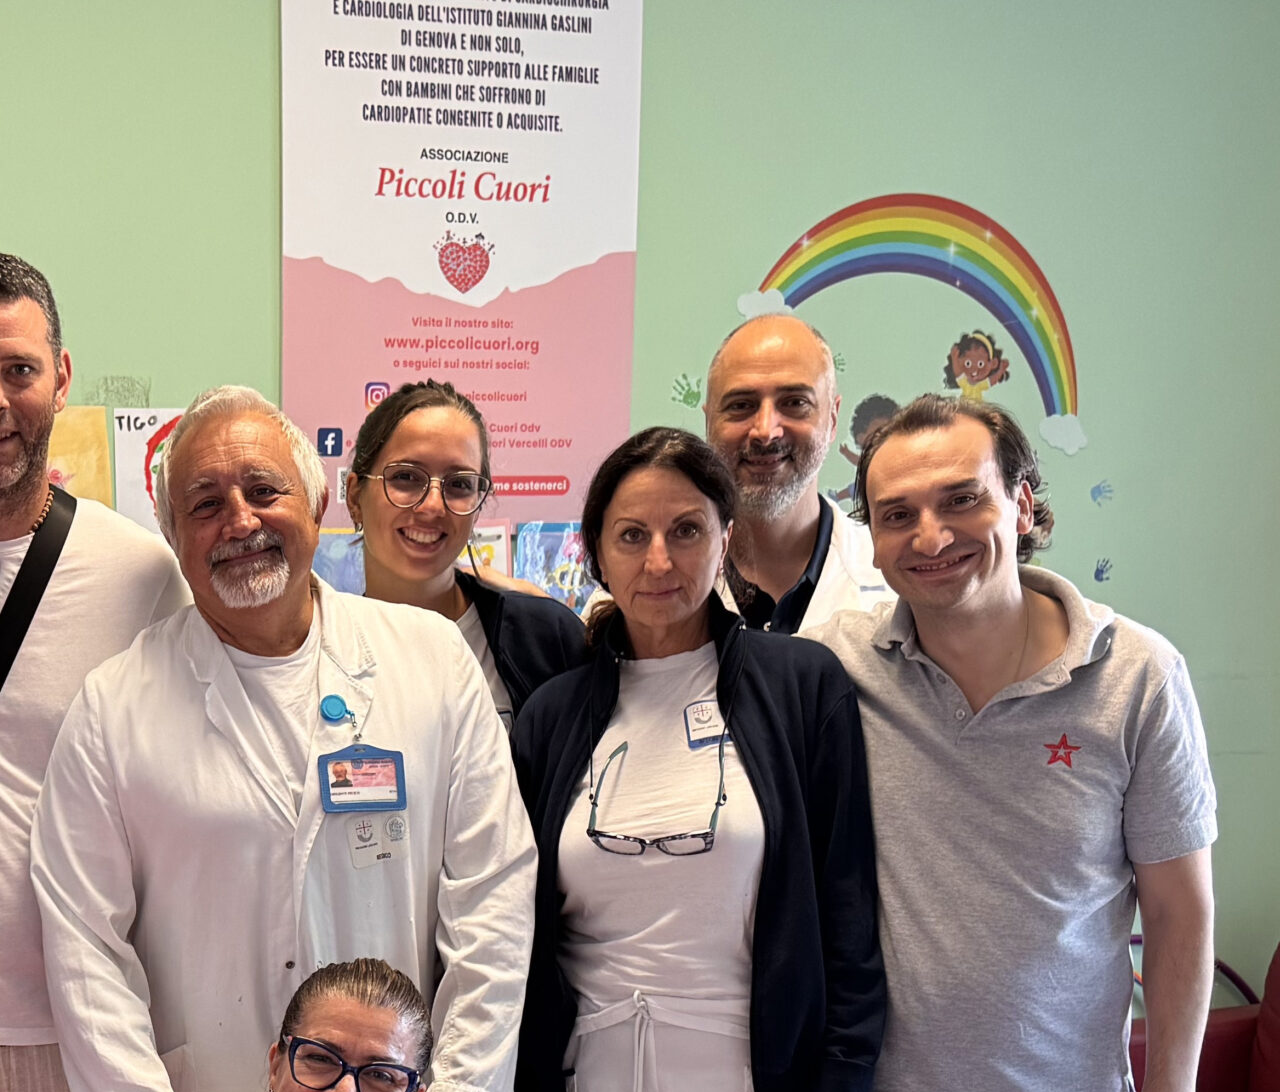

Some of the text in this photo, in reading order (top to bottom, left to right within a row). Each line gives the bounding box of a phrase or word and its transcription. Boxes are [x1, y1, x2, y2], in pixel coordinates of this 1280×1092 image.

[333, 0, 340, 15] E
[343, 0, 414, 20] CARDIOLOGIA
[418, 5, 492, 26] DELL'ISTITUTO
[497, 12, 547, 30] GIANNINA
[551, 15, 591, 33] GASLINI
[401, 29, 524, 56] DI GENOVA E NON SOLO,
[325, 49, 599, 84] PER ESSERE UN CONCRETO SUPPORTO ALLE FAMIGLIE
[381, 79, 545, 106] CON BAMBINI CHE SOFFRONO DI
[363, 104, 562, 132] CARDIOPATIE CONGENITE O ACQUISITE.
[420, 148, 508, 163] ASSOCIAZIONE
[375, 168, 551, 203] Piccoli Cuori
[446, 212, 479, 224] O.D.V.
[411, 317, 513, 329] Visita il nostro sito:
[384, 336, 540, 355] www.piccolicuori.org
[393, 359, 530, 371] o seguici sui nostri social:
[489, 423, 541, 433] Cuori Odv
[509, 439, 548, 448] Vercelli
[550, 438, 572, 448] ODV
[512, 480, 567, 491] sostenerci
